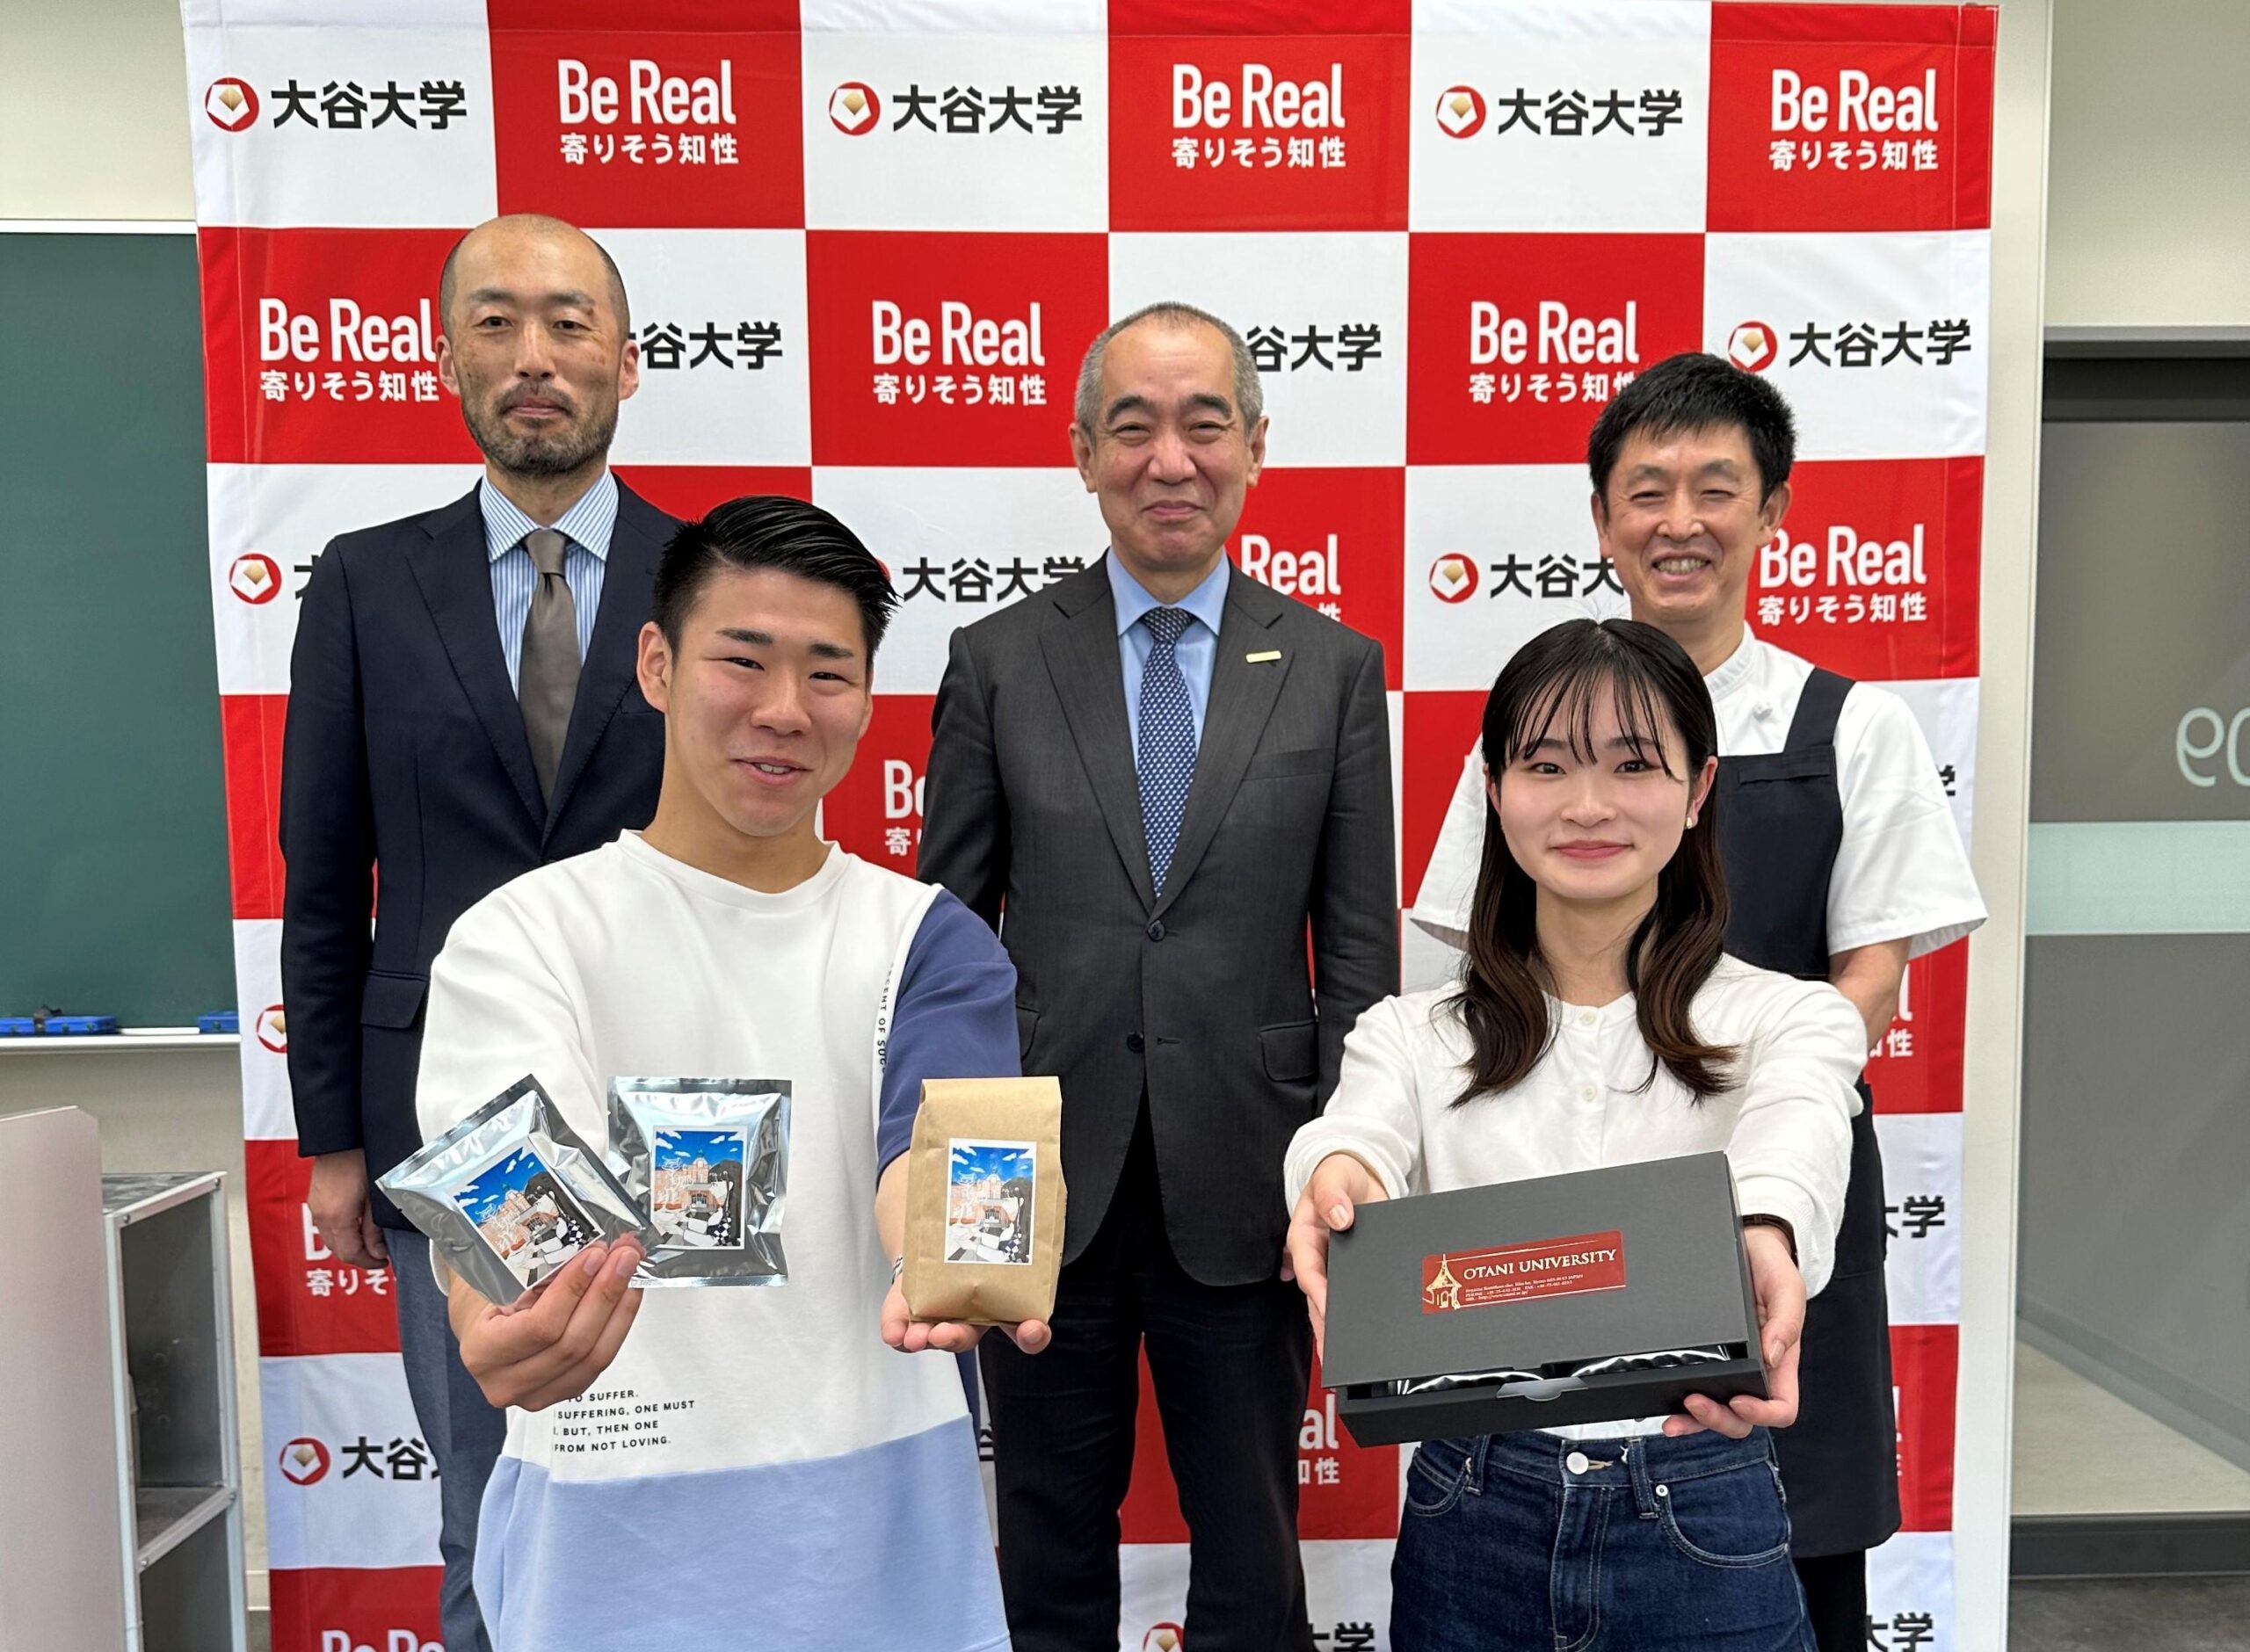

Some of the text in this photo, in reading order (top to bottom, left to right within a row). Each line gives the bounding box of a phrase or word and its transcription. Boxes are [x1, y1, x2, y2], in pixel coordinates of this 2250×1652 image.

[272, 80, 467, 129] 大谷大学
[559, 60, 736, 124] Be Real
[893, 85, 1081, 134] 大谷大学
[1173, 63, 1345, 128] Be Real
[1499, 89, 1681, 135] 大谷大学
[1772, 69, 1938, 132] Be Real
[561, 133, 738, 164] 寄りそう知性
[1172, 136, 1346, 169] 寄りそう知性
[1769, 140, 1938, 170] 寄りそう知性
[260, 299, 436, 362] Be Real
[629, 322, 782, 369] 谷大学
[873, 301, 1044, 366] Be Real
[1471, 301, 1639, 364] Be Real
[1790, 320, 1971, 366] 大谷大学
[261, 370, 439, 402] 寄りそう知性
[874, 373, 1046, 405] 寄りそう知性
[1241, 533, 1341, 595] Real
[1760, 525, 1927, 588] Be Real
[1759, 591, 1927, 625] 寄りそう知性
[878, 1018, 886, 1033] OF
[1464, 1250, 1616, 1279] OTANI UNIVERSITY
[558, 1401, 695, 1419] SUFFERING, ONE MUST
[590, 1390, 639, 1402] SUFFER.
[555, 1437, 671, 1453] FROM NOT LOVING.
[563, 1427, 592, 1437] BUT,
[597, 1424, 629, 1434] THEN
[635, 1421, 658, 1431] ONE
